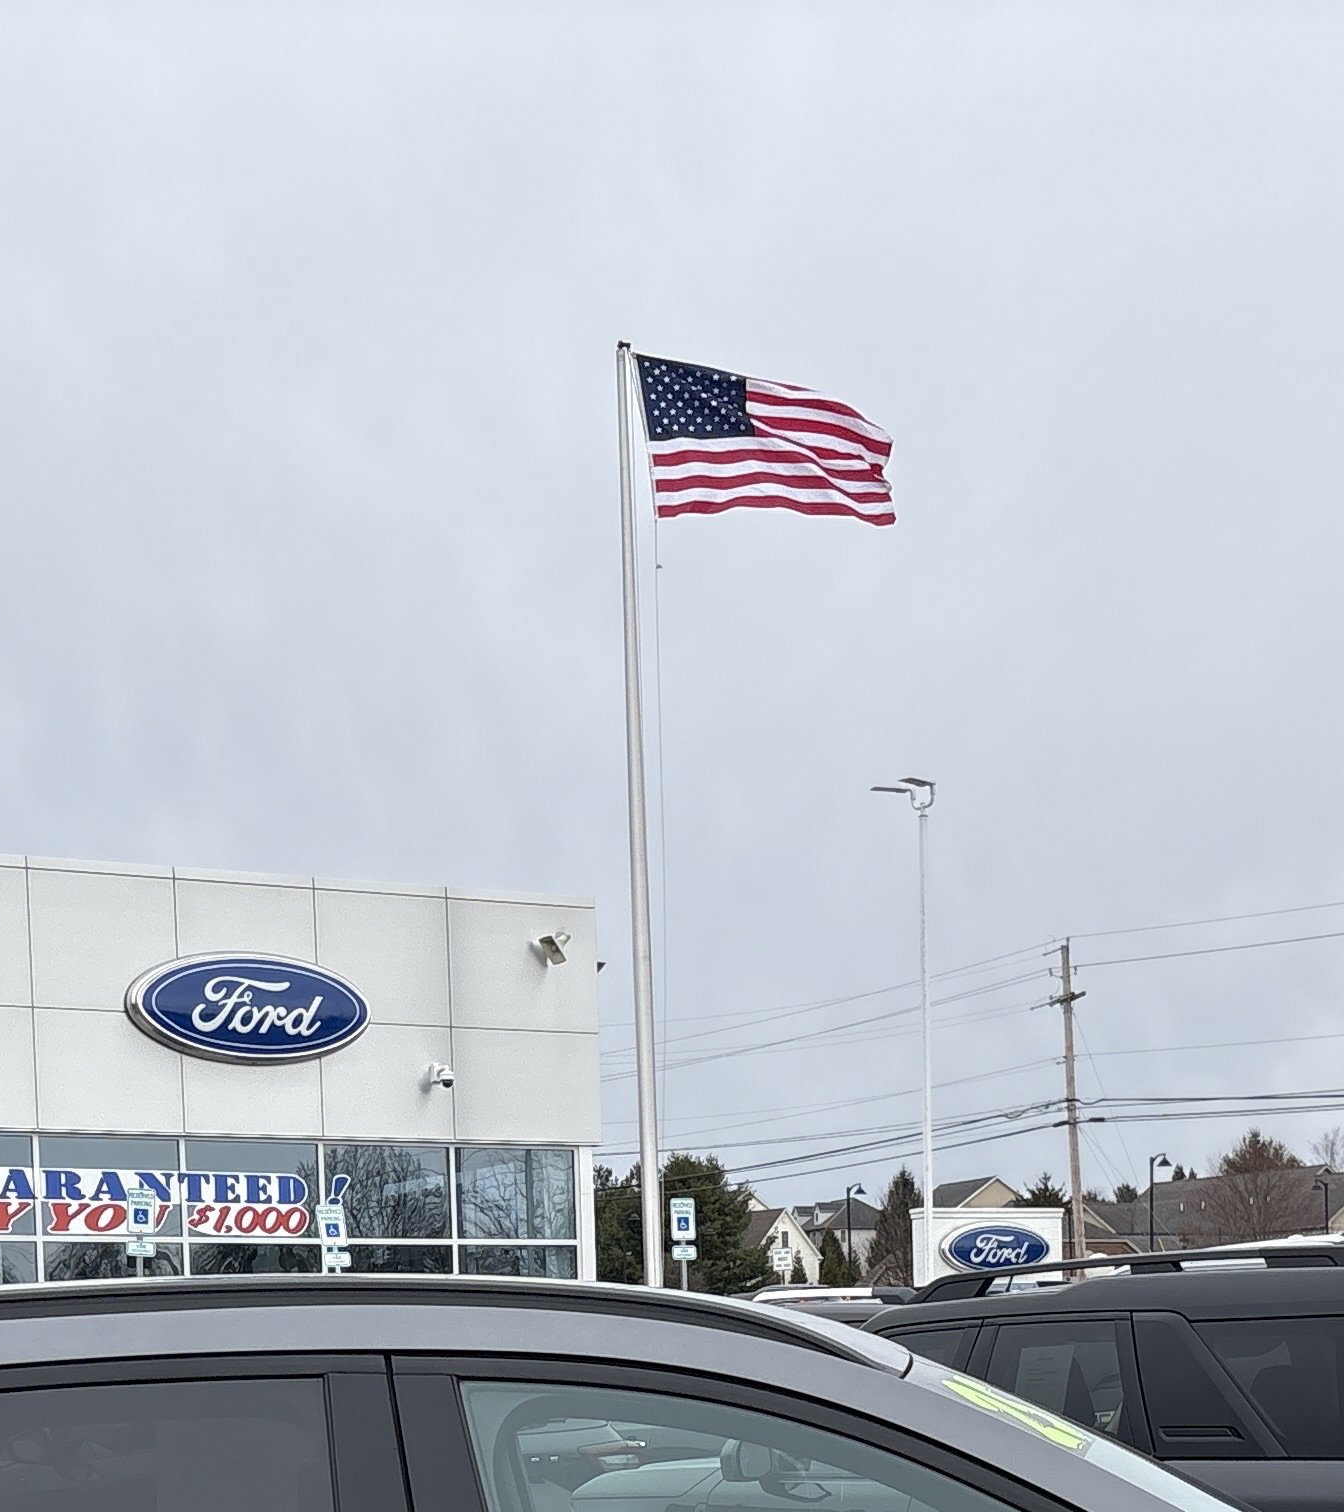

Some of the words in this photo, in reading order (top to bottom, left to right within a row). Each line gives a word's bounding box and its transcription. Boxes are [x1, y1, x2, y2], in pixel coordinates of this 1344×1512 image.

[191, 975, 324, 1037] Ford
[187, 1204, 308, 1235] $1,000
[969, 1233, 1029, 1264] Ford
